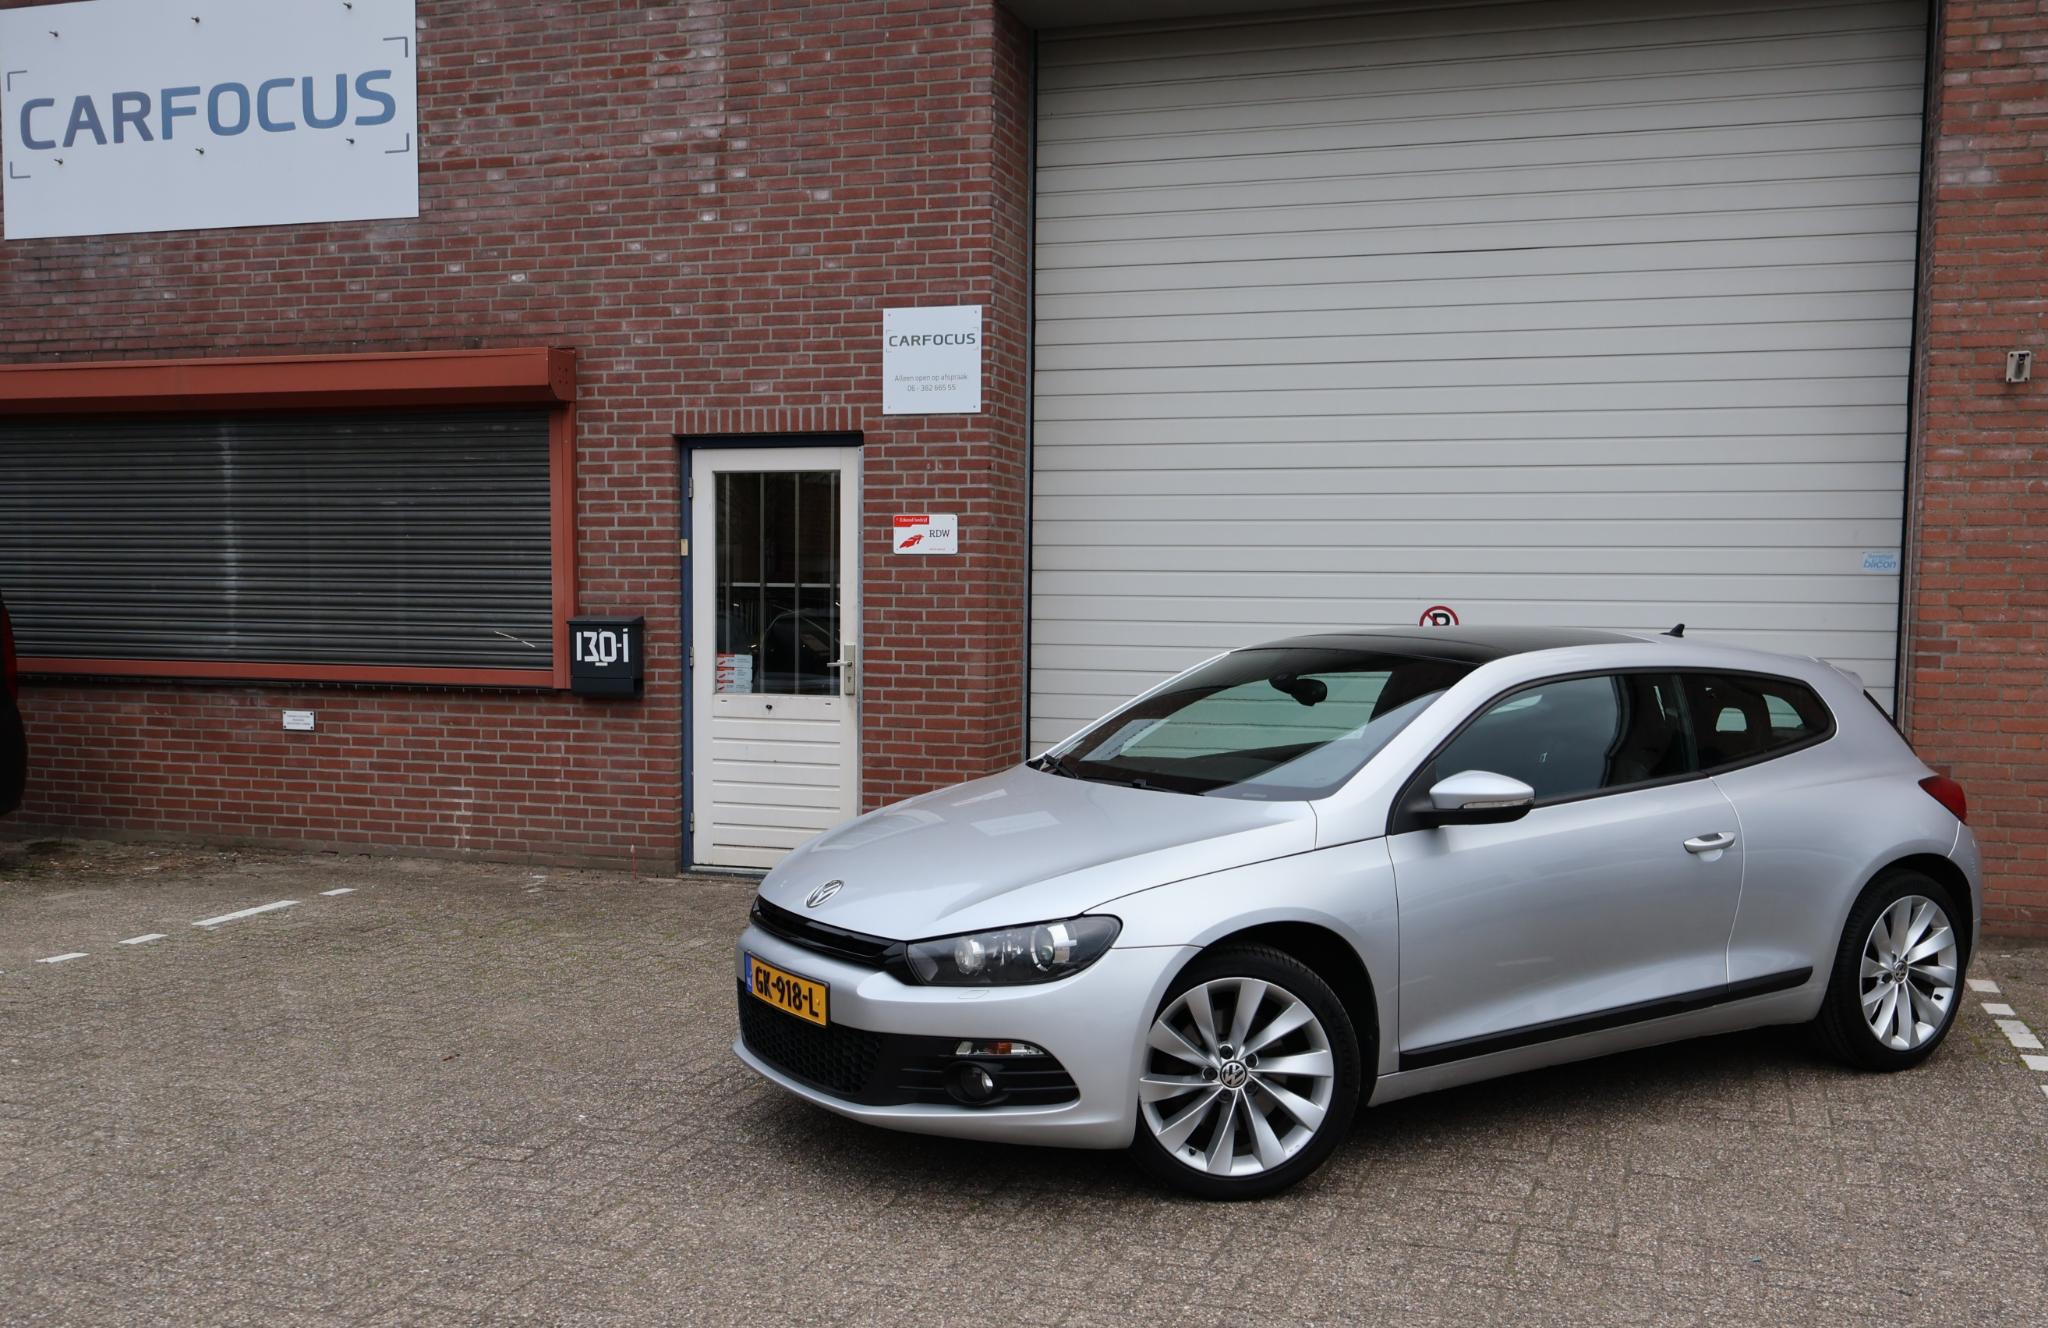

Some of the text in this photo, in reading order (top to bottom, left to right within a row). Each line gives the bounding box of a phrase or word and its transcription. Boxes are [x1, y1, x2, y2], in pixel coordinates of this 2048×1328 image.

[20, 69, 397, 151] CARFOCUS
[888, 333, 976, 347] CARFOCUS
[894, 374, 914, 382] Alleen
[915, 375, 930, 383] open
[929, 529, 950, 538] RDW
[1863, 558, 1897, 569] blicon
[755, 966, 819, 1018] GK-918-L
